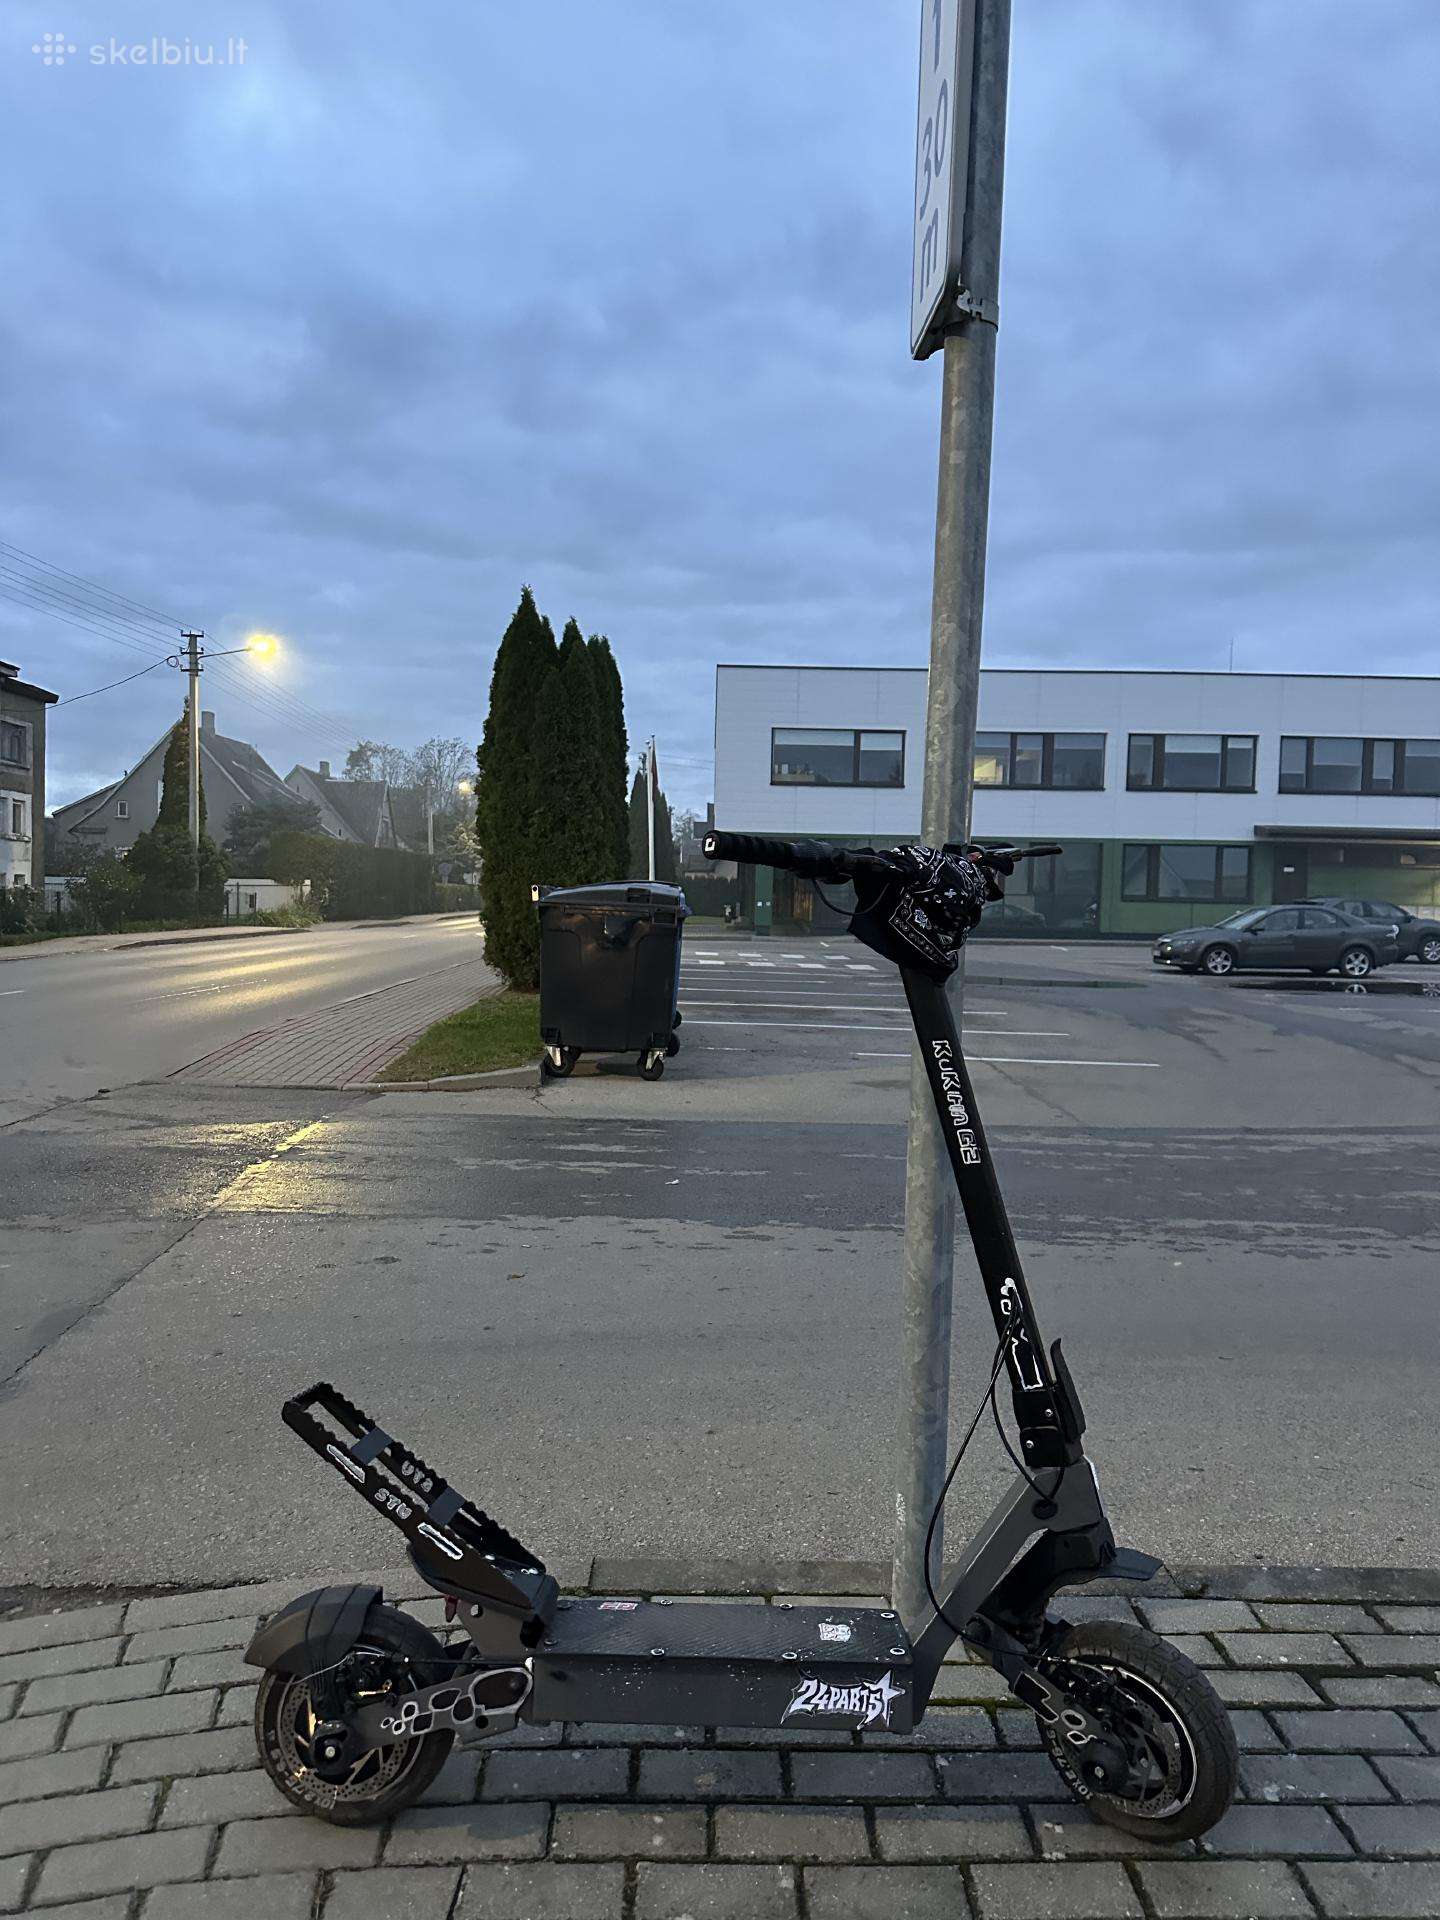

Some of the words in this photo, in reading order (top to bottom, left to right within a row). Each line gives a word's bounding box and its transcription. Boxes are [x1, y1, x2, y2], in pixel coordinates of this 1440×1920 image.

[919, 78, 949, 222] 30
[956, 1128, 982, 1166] G2
[788, 1676, 884, 1726] 24PARTS
